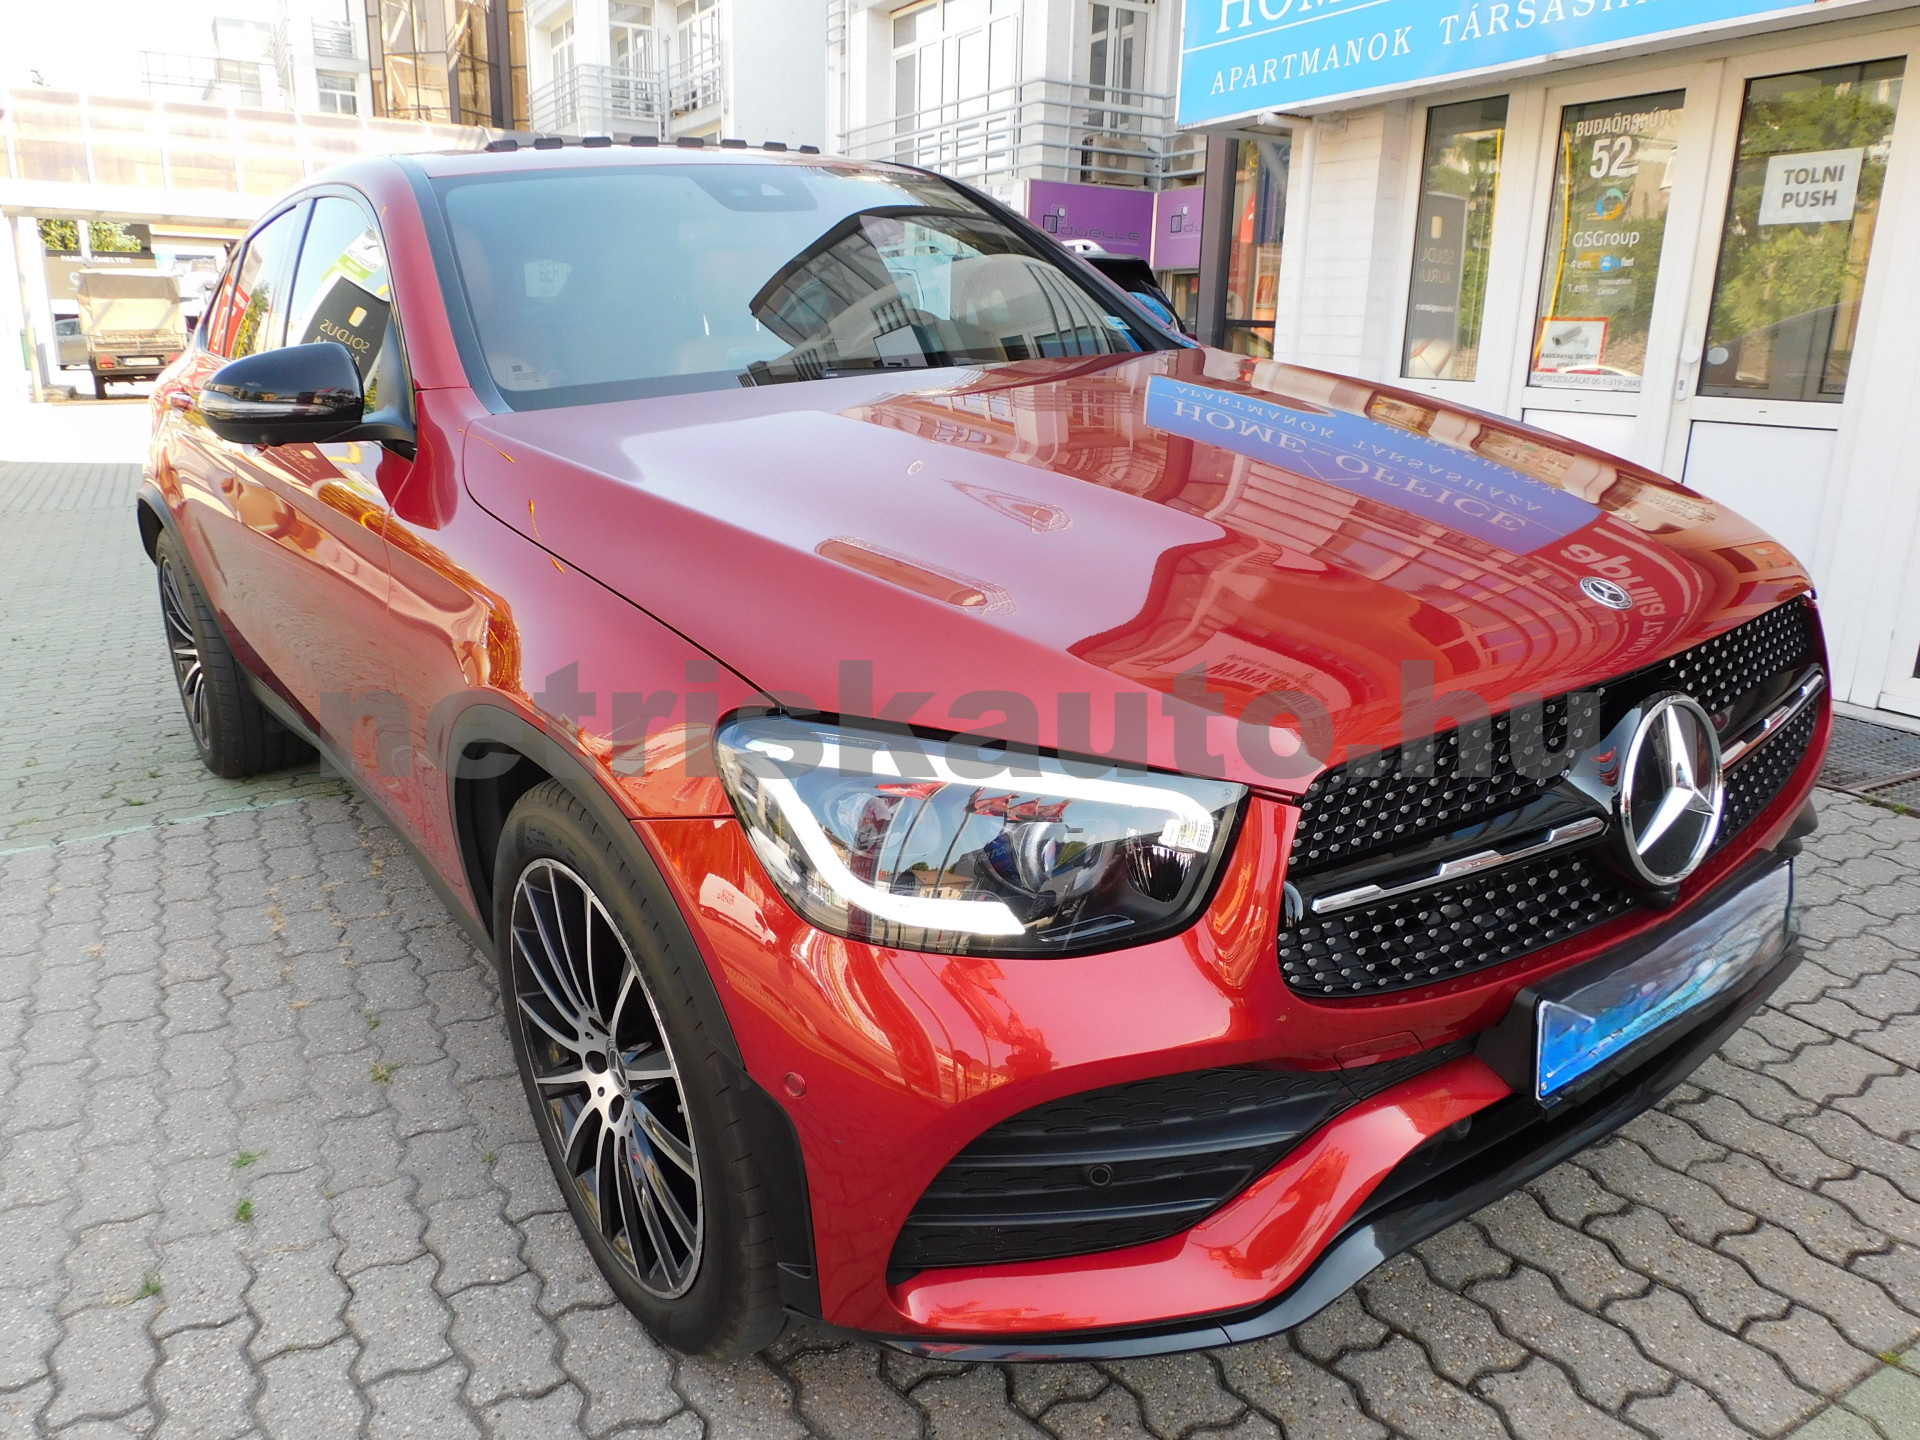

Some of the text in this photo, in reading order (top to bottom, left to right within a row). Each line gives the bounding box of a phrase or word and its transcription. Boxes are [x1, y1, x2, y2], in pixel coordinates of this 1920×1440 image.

[1210, 25, 1413, 95] APARTMANOK
[1589, 135, 1639, 179] 52
[1783, 164, 1846, 186] TOLNI
[1780, 189, 1838, 209] PUSH
[1572, 230, 1640, 248] GSGroup
